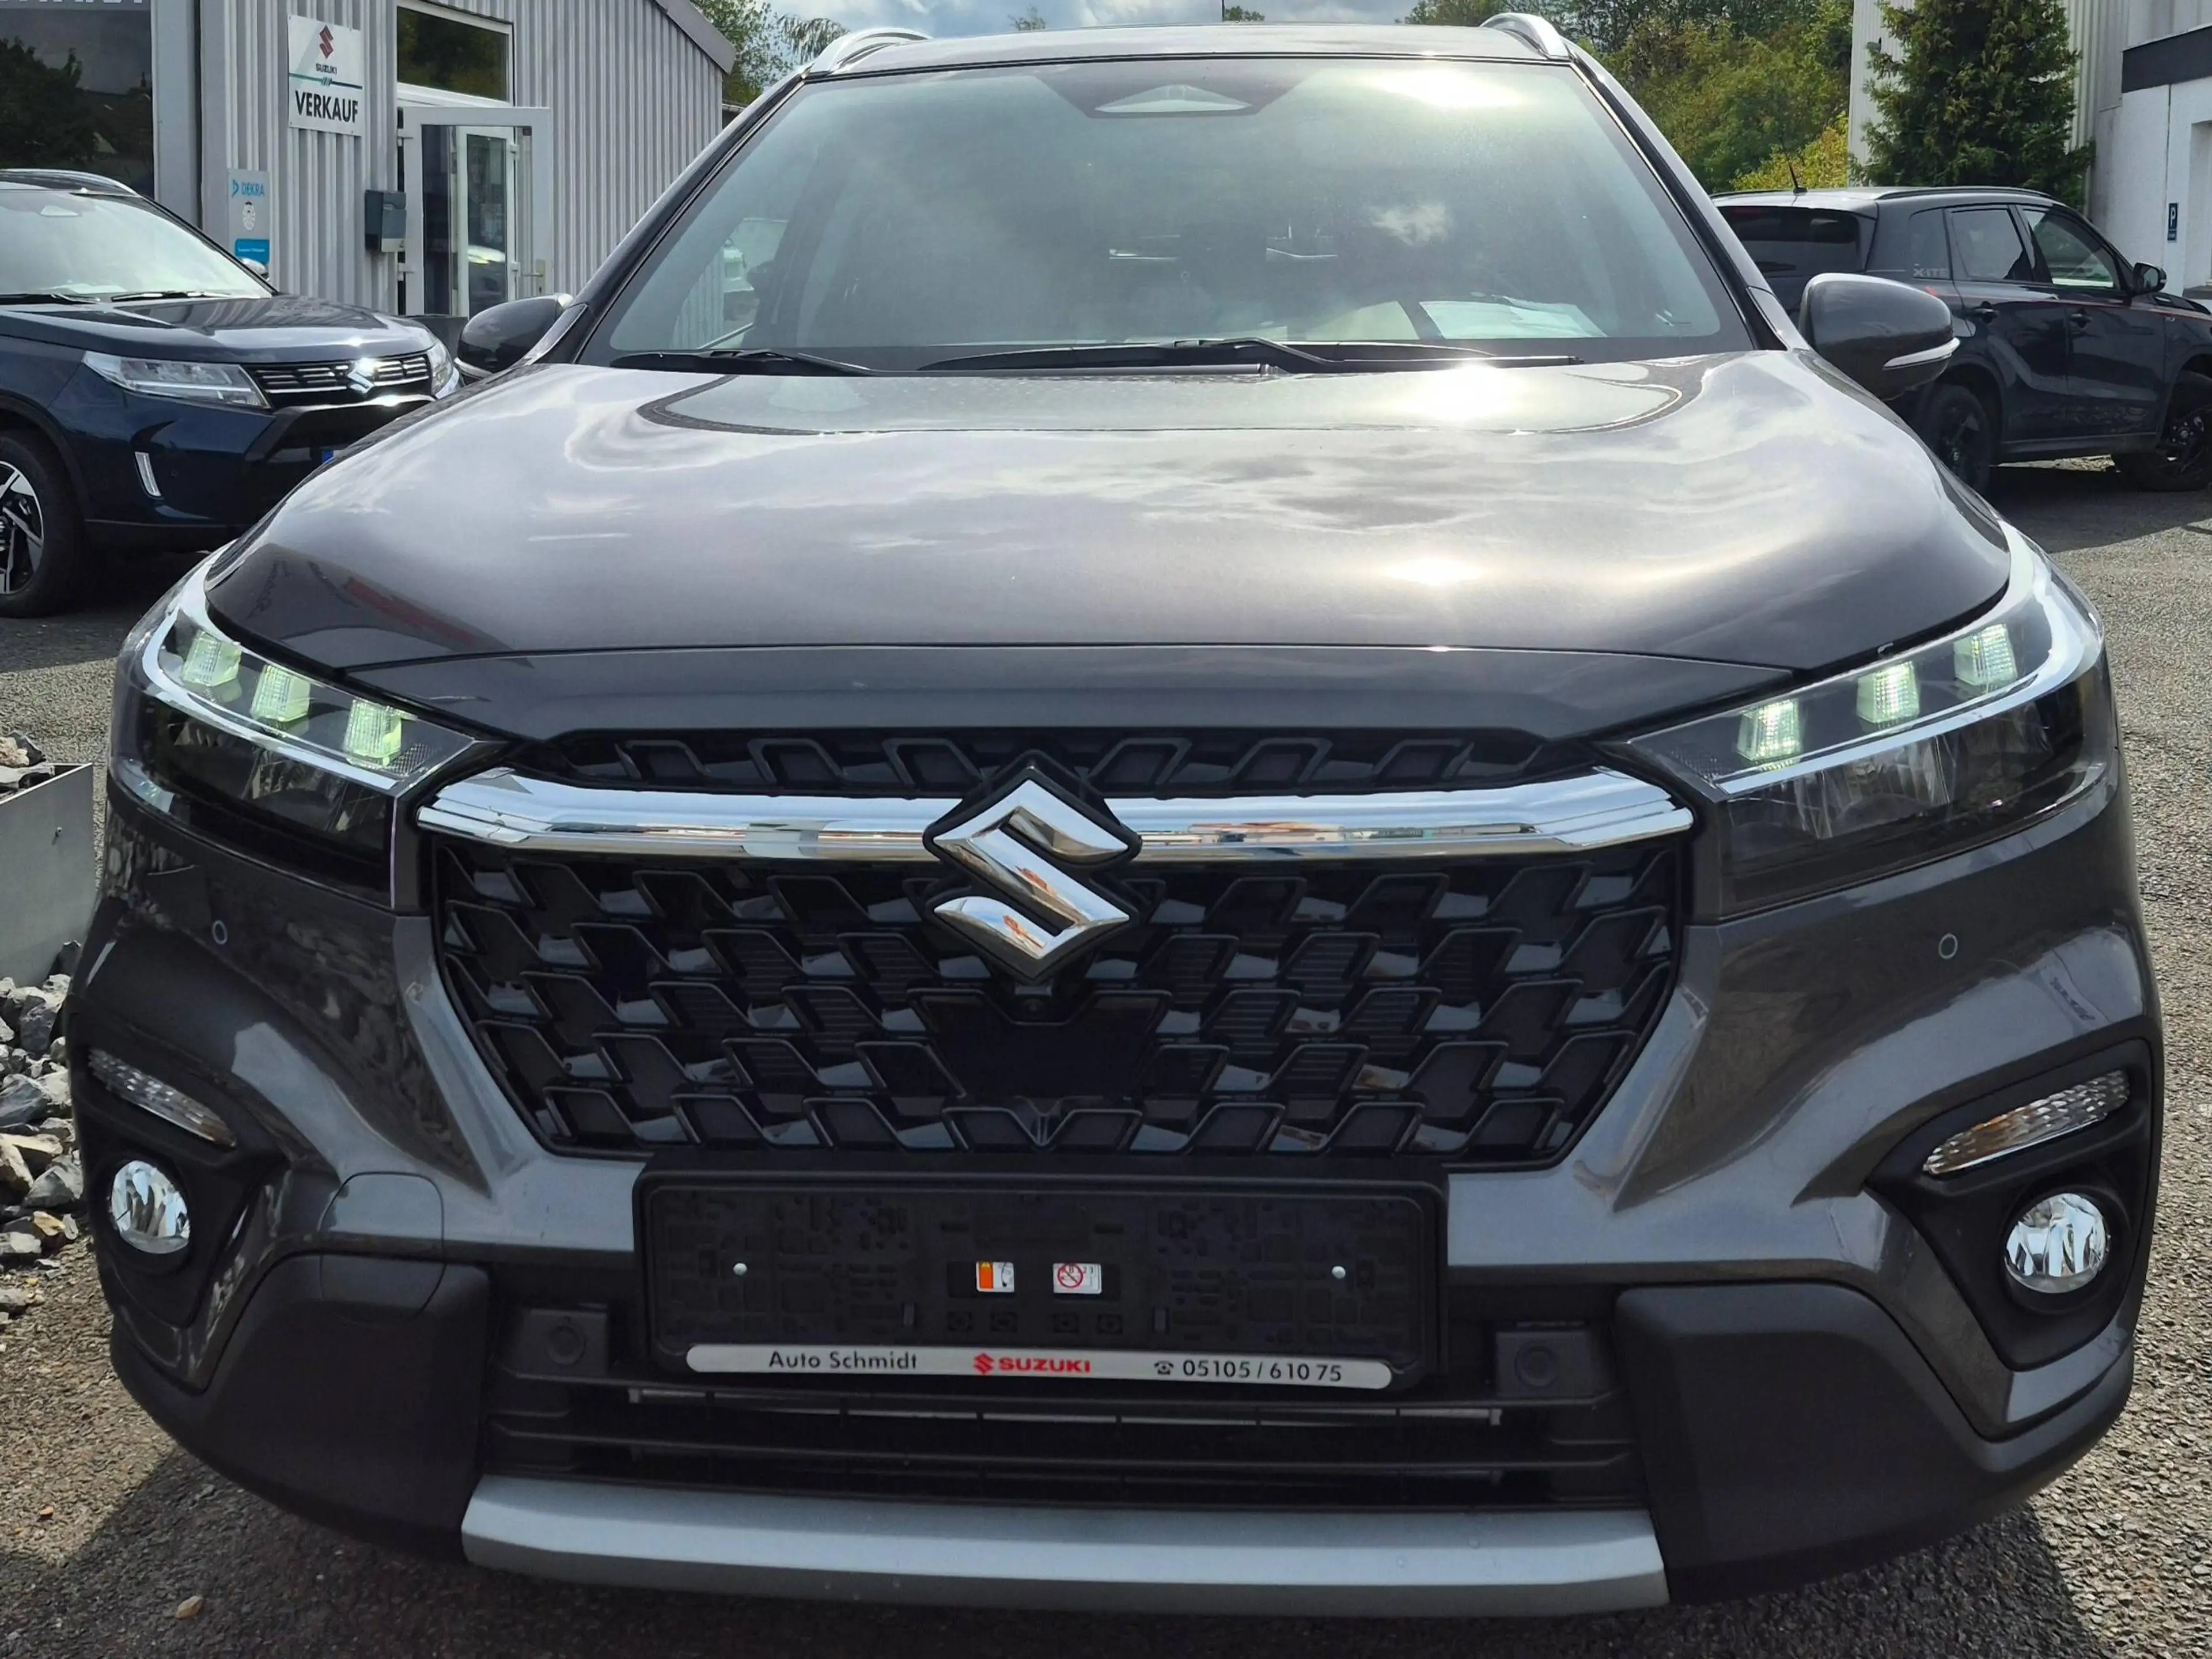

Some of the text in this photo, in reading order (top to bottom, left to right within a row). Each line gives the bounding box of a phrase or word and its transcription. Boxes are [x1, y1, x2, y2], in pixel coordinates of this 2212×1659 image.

[316, 63, 337, 74] SUZUKI
[295, 89, 358, 123] VERKAUF
[241, 181, 265, 197] DEKRA
[769, 1351, 821, 1368] Auto
[830, 1351, 917, 1369] Schmidt
[999, 1357, 1090, 1373] SUZUKI
